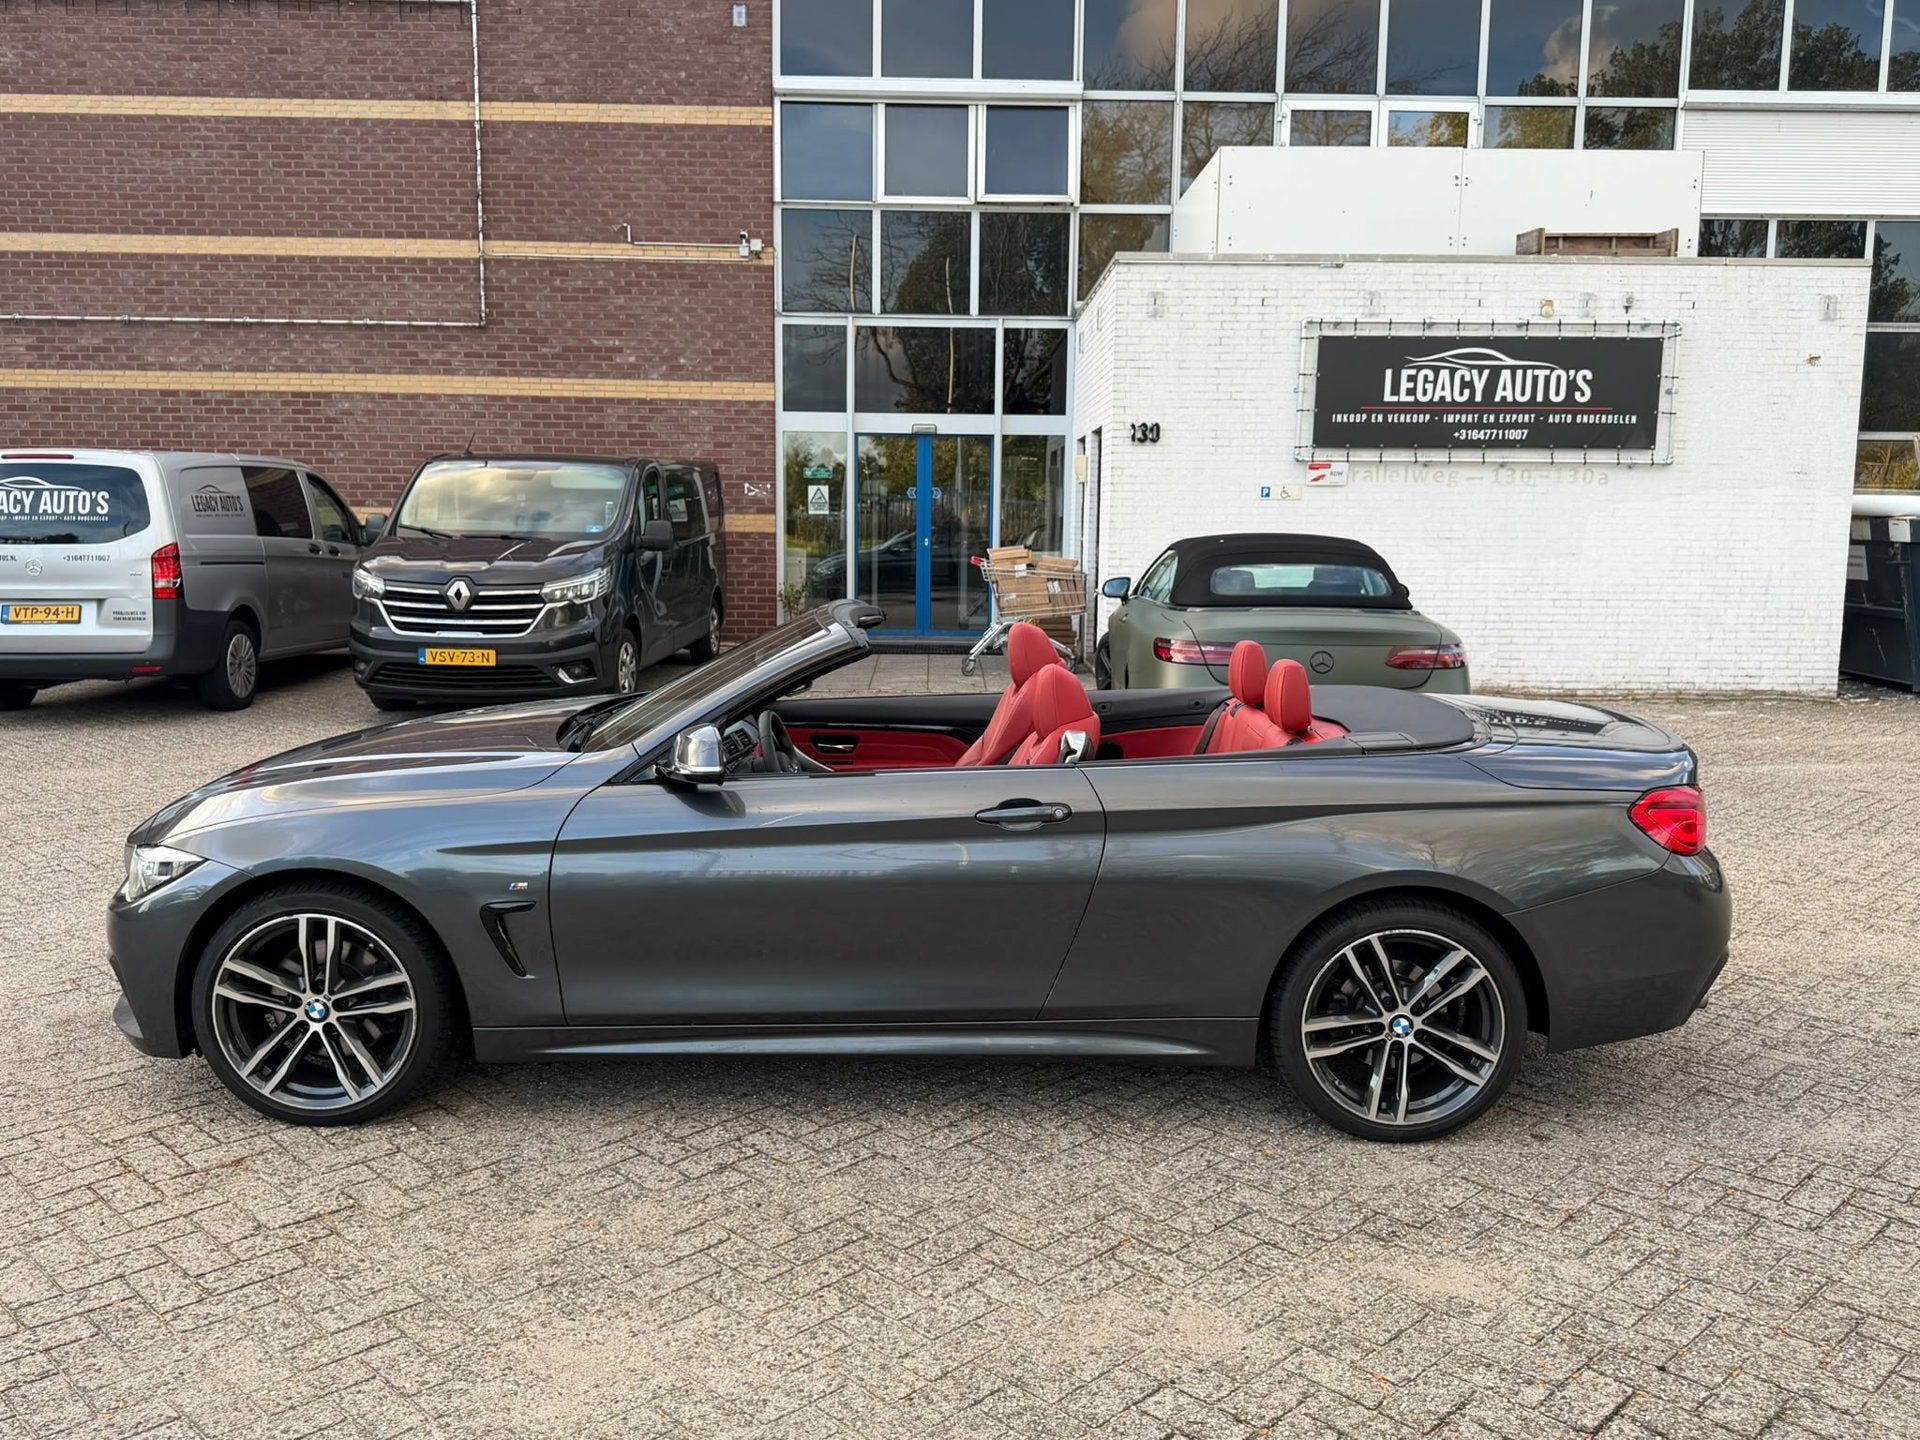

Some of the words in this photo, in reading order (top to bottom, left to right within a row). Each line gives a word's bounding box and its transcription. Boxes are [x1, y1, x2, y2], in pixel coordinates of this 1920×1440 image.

[1383, 368, 1490, 403] LEGACY
[1494, 368, 1594, 403] AUTO'S
[1332, 413, 1368, 423] INKOOP
[1371, 413, 1383, 423] EN
[1387, 413, 1431, 423] VERKOOP
[1443, 413, 1479, 423] IMPORT
[1483, 413, 1495, 423] EN
[1499, 413, 1535, 423] EXPORT
[1548, 414, 1572, 424] AUTO
[1576, 414, 1637, 425] ONDERDELEN
[1130, 422, 1160, 443] 130
[1453, 429, 1529, 440] +31647711007
[39, 490, 110, 515] AUTO'S
[191, 495, 219, 512] LEGACY
[14, 607, 74, 618] VTP-94-H
[430, 651, 490, 663] VSV-73-N
